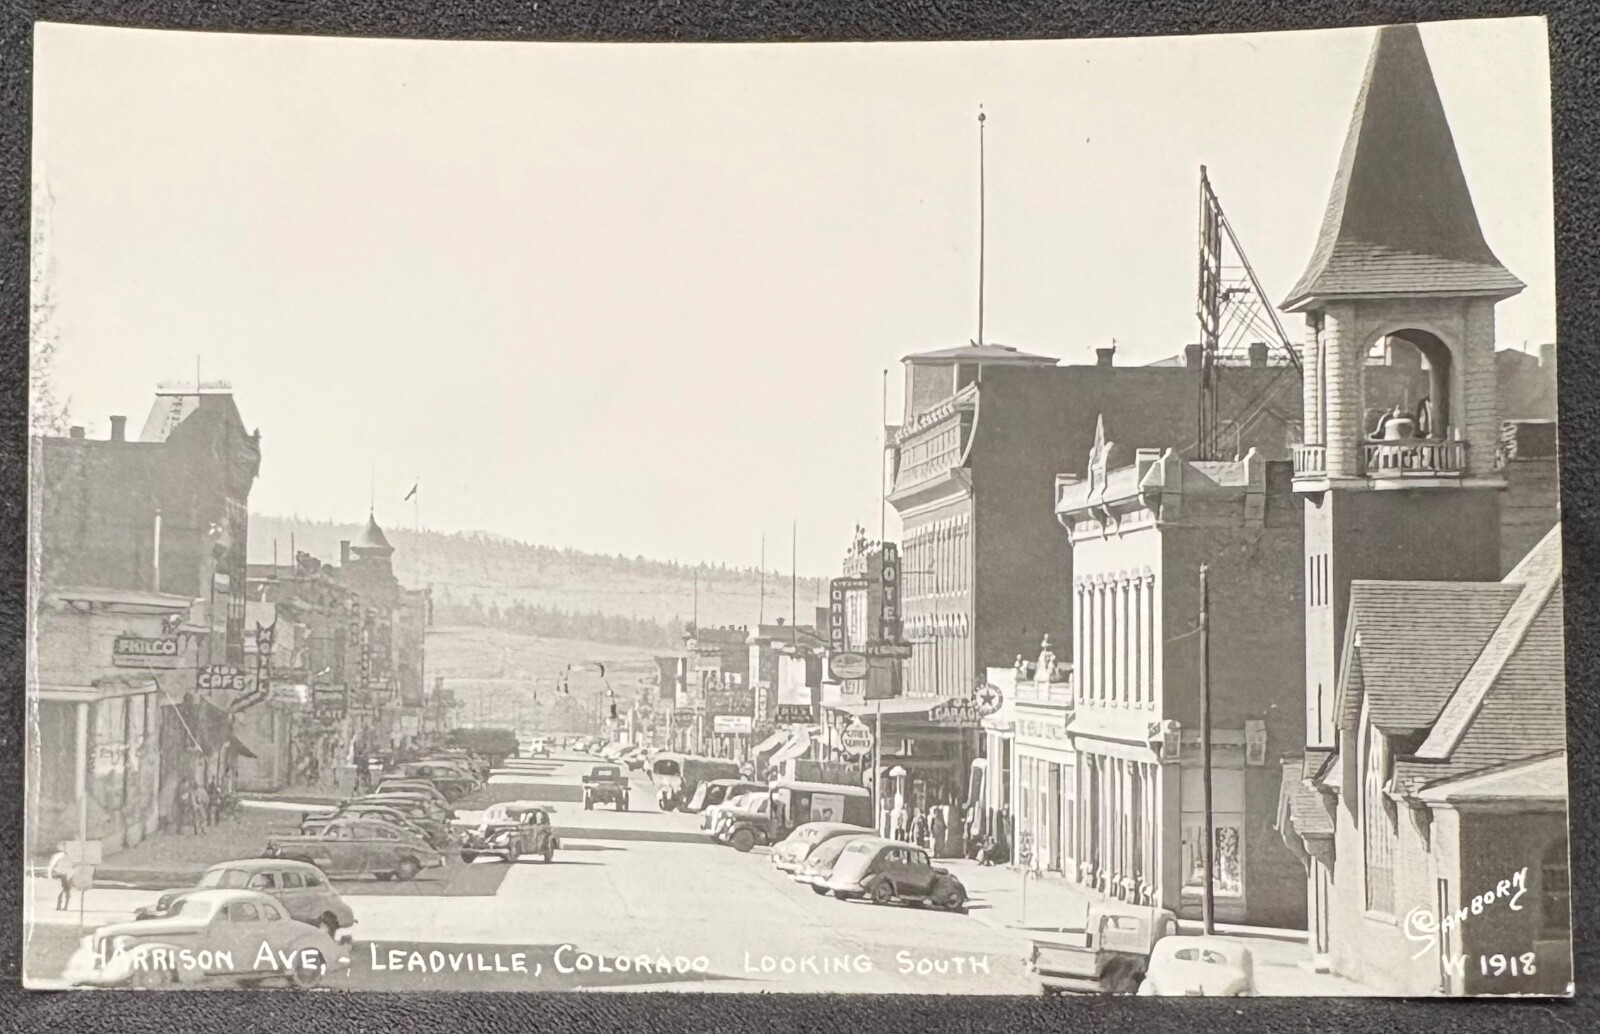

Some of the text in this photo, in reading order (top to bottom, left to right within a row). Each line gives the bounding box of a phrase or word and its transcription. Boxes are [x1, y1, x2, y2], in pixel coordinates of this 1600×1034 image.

[883, 547, 896, 640] HOTEL
[119, 639, 177, 655] PHILCO
[198, 674, 245, 690] CAFE
